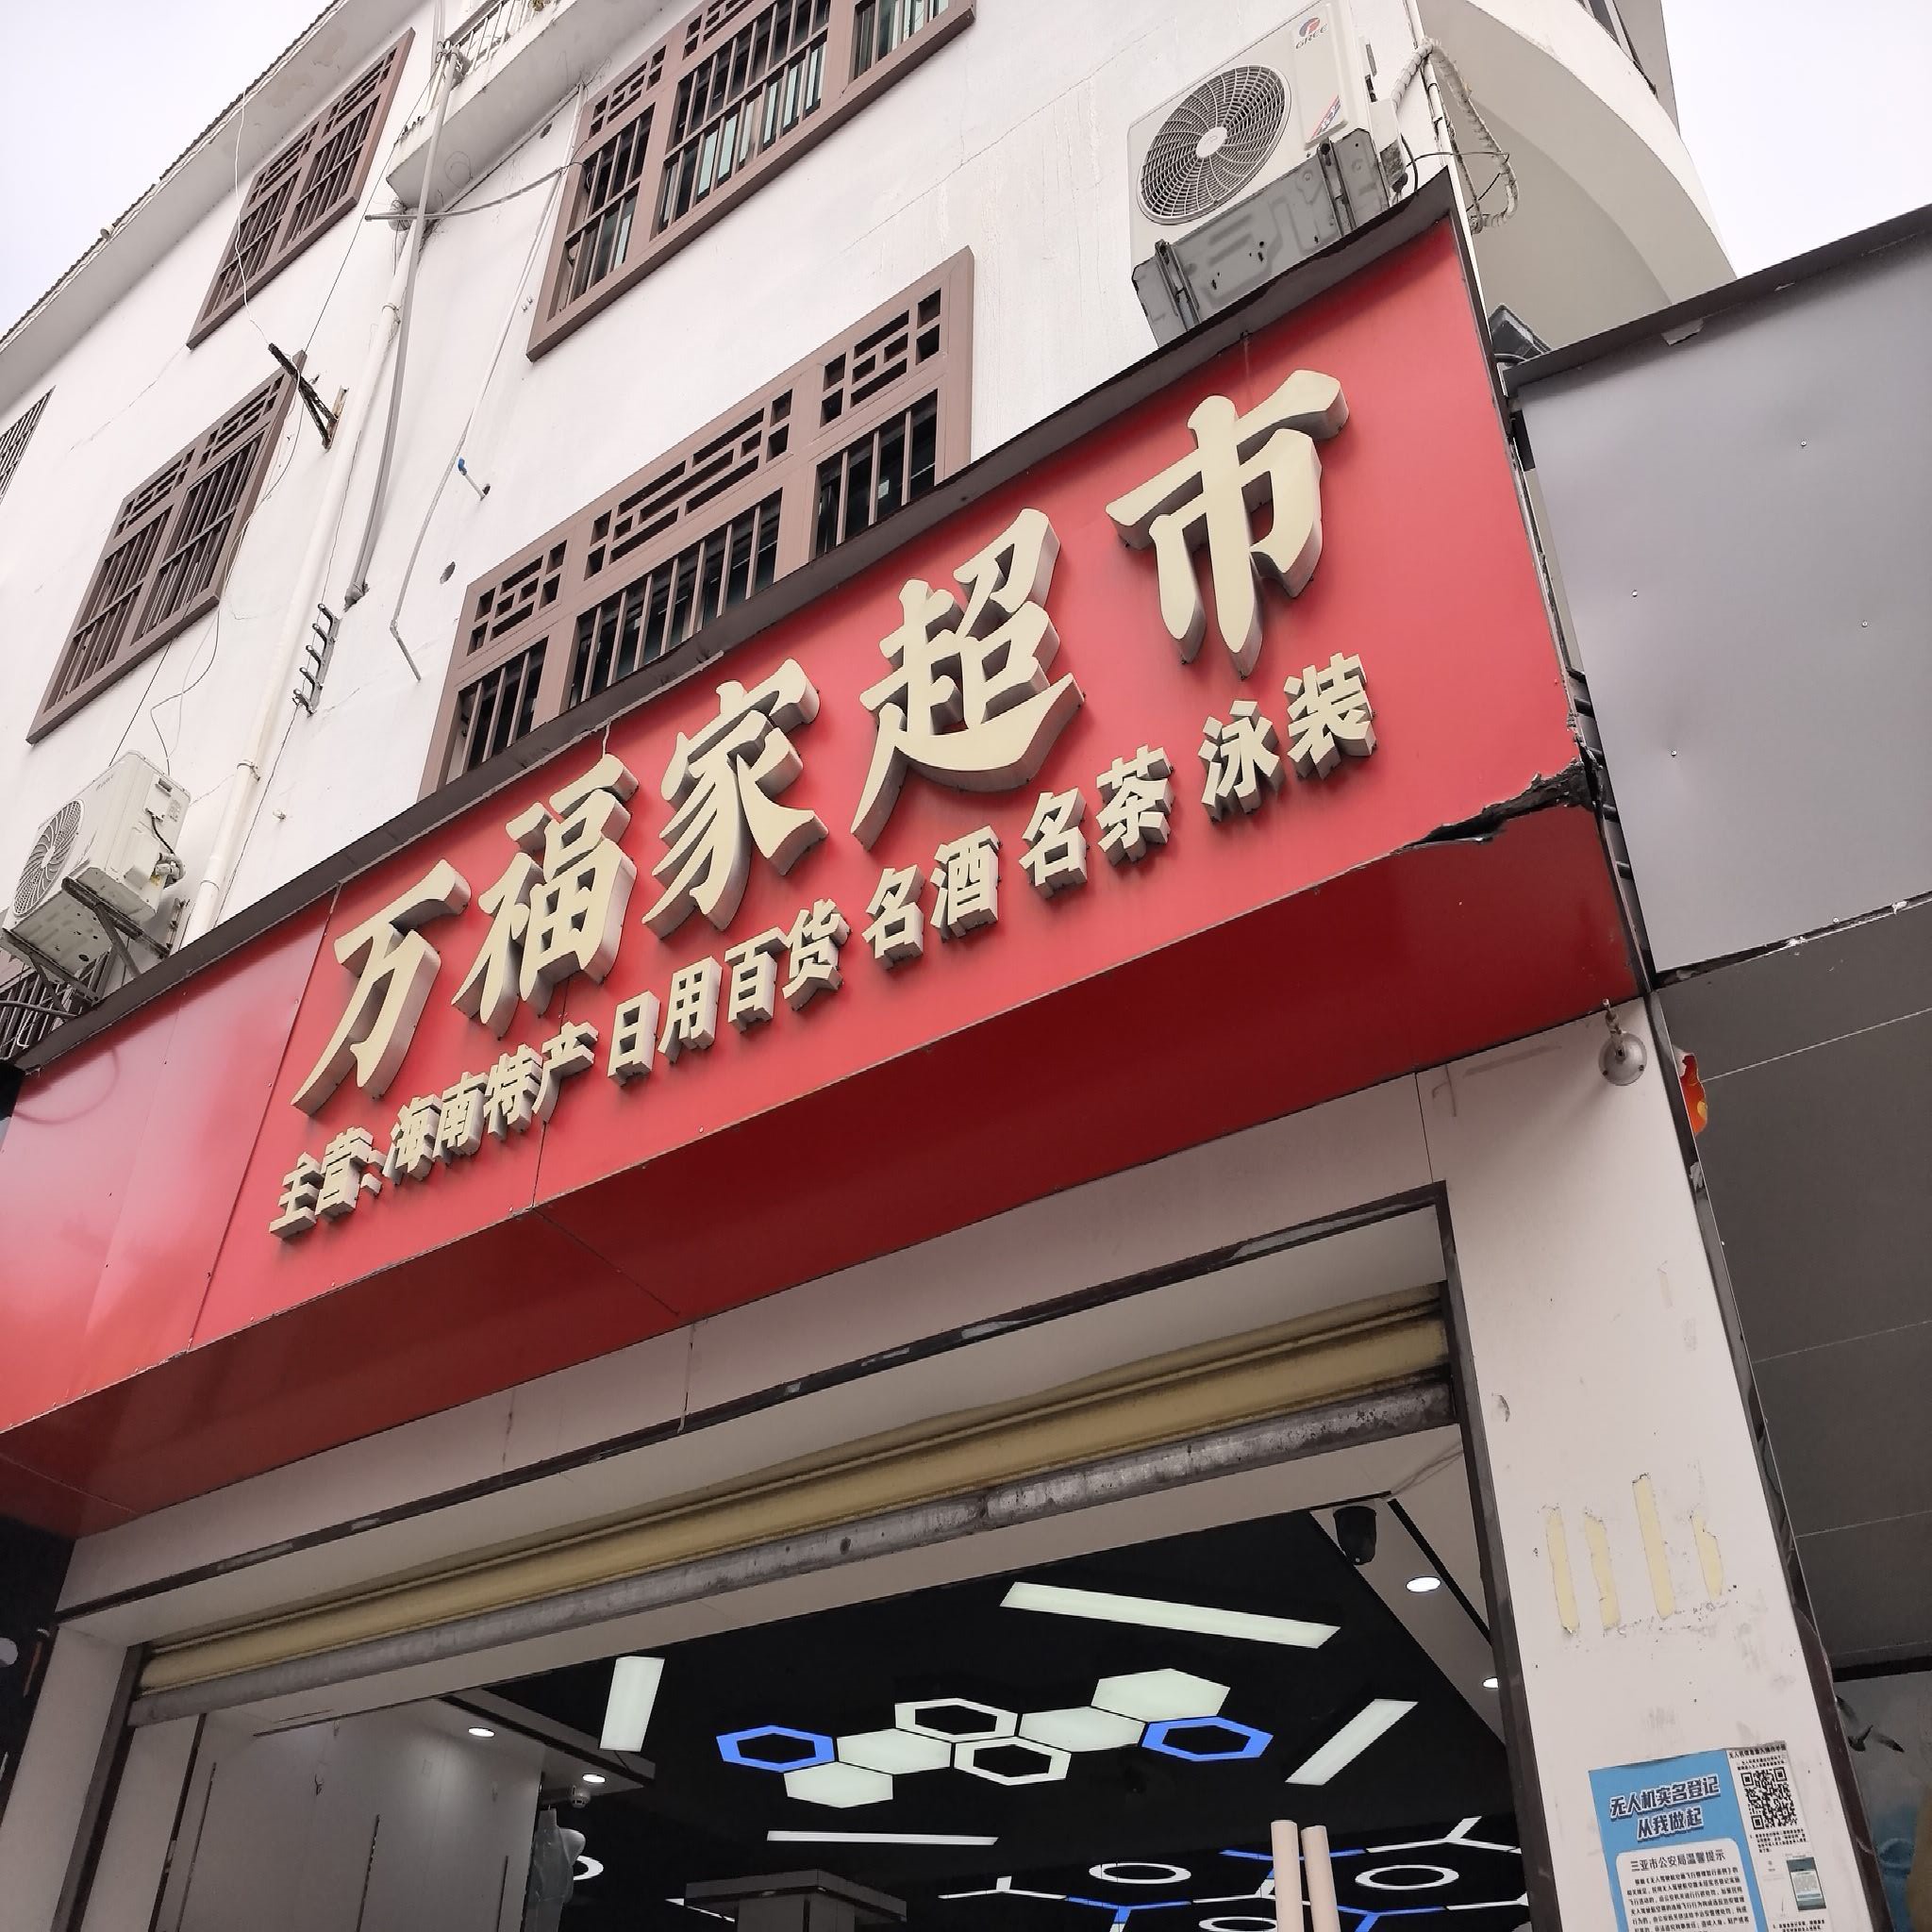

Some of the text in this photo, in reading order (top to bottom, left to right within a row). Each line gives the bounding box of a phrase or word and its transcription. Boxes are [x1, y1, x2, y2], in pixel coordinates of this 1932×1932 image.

[291, 369, 1349, 1115] 万福家超市
[607, 897, 851, 1087] 日用百货
[861, 825, 1003, 969] 名酒
[1019, 744, 1174, 897] 名茶
[1198, 653, 1376, 821] 泳装
[1609, 1774, 1720, 1820] 无人机实名登记
[1637, 1806, 1703, 1840] 从我做起
[1630, 1849, 1726, 1873] 三亚市公安局温馨提示
